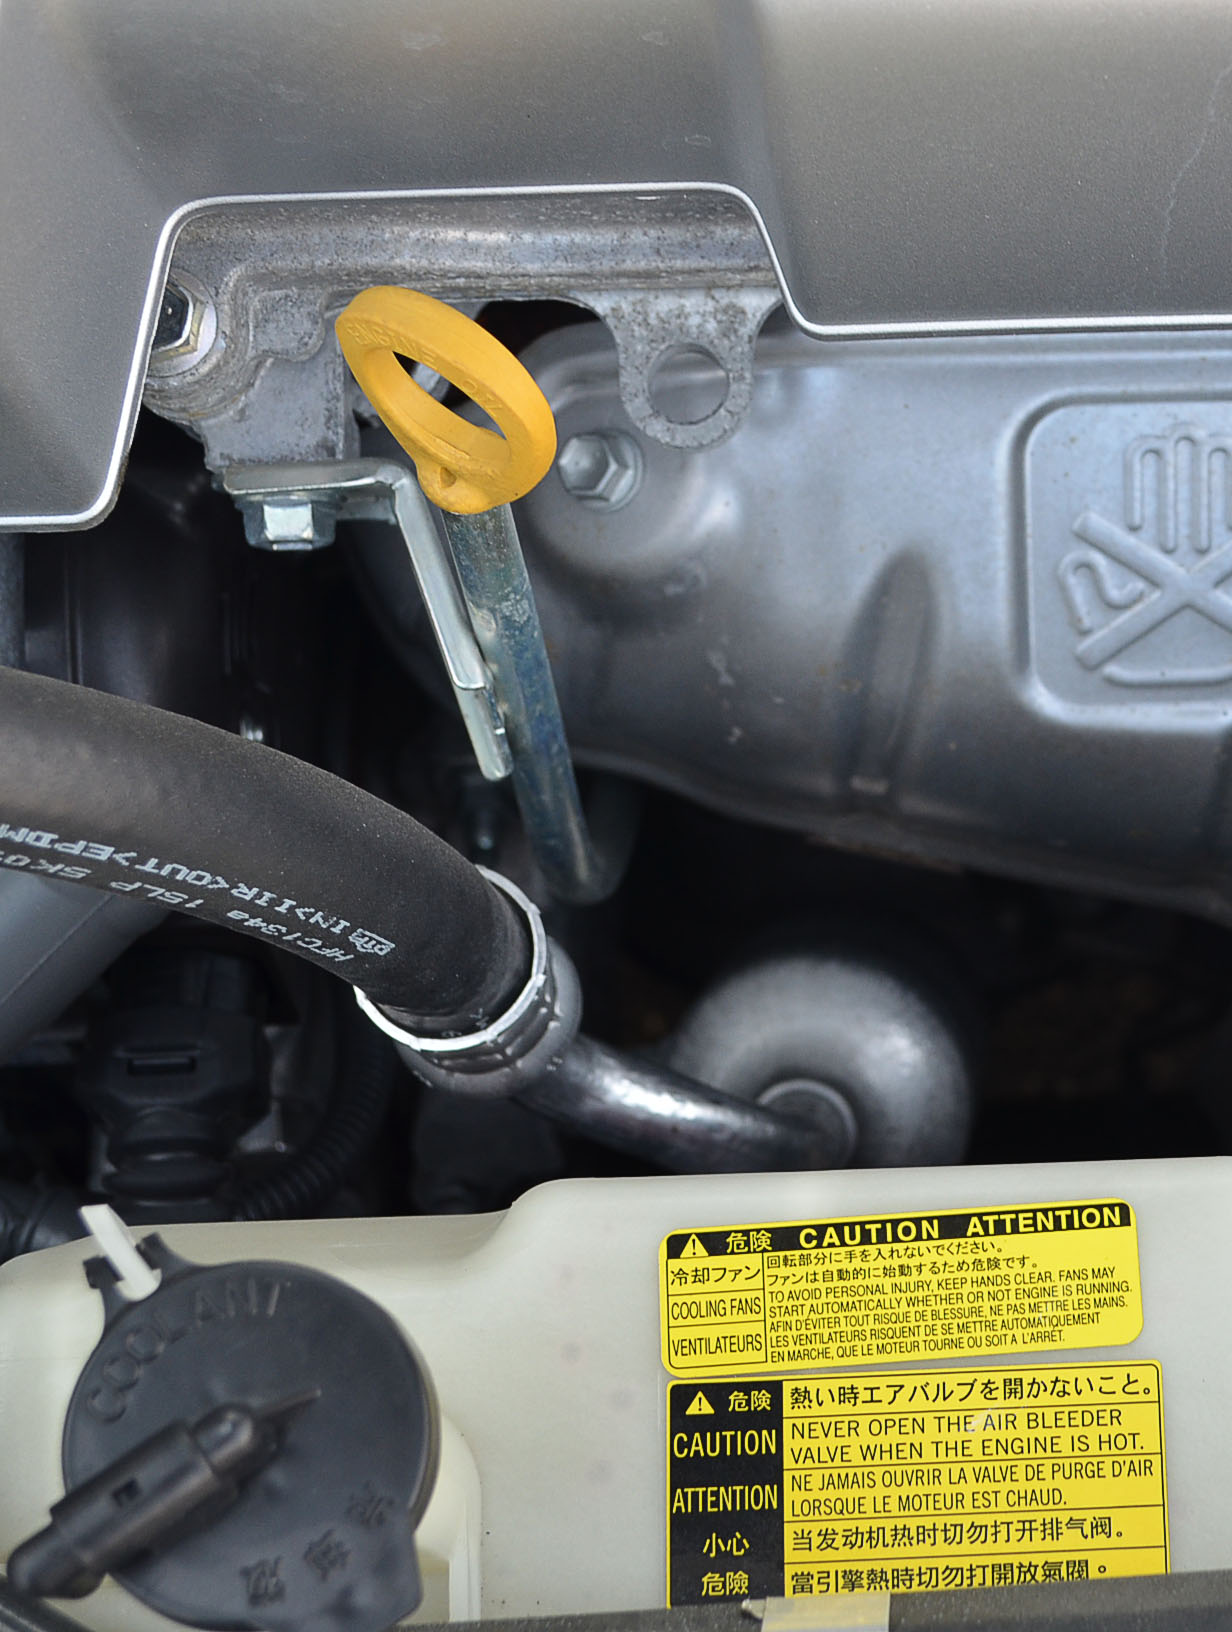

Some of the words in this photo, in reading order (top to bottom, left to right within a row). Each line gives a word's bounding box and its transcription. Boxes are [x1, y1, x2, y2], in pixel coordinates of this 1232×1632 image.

[226, 909, 355, 961] HFC134a
[726, 1230, 772, 1253] 危険
[799, 1219, 939, 1248] CAUTION
[966, 1206, 1120, 1236] ATTENTION
[767, 1240, 1003, 1269] 回転部分に手を入れないでください。
[670, 1265, 761, 1286] 冷却ファン
[767, 1256, 1038, 1286] ファンは自動的に始動するため危険です。
[768, 1288, 784, 1302] TO
[787, 1286, 821, 1301] AVOID
[825, 1281, 888, 1298] PERSONAL
[891, 1278, 933, 1294] INJURY,
[937, 1276, 967, 1291] KEEP
[971, 1273, 1010, 1288] HANDS
[1014, 1270, 1054, 1285] CLEAR.
[1059, 1267, 1088, 1282] FANS
[1091, 1265, 1115, 1280] MAY
[671, 1299, 726, 1320] COOLING
[730, 1297, 761, 1316] FANS
[769, 1302, 805, 1317] START
[808, 1295, 902, 1315] AUTOMATICALLY
[905, 1291, 963, 1308] WHETHER
[966, 1290, 983, 1304] OR
[987, 1288, 1011, 1302] NOT
[1014, 1284, 1058, 1300] ENGINE
[1062, 1283, 1072, 1297] IS
[1076, 1279, 1131, 1296] RUNNING.
[769, 1318, 792, 1332] AFIN
[795, 1314, 840, 1330] D'ÉVITER
[843, 1312, 870, 1327] TOUT
[873, 1309, 911, 1325] RISQUE
[914, 1308, 928, 1322] DE
[931, 1304, 987, 1321] BLESSURE,
[989, 1303, 1003, 1317] NE
[1006, 1302, 1025, 1316] PAS
[1028, 1299, 1069, 1314] METTRE
[1072, 1297, 1090, 1311] LES
[1093, 1295, 1127, 1310] MAINS.
[770, 1333, 789, 1347] LES
[791, 1328, 867, 1346] VENTILATEURS
[870, 1324, 921, 1340] RISQUENT
[924, 1323, 938, 1337] DE
[941, 1322, 954, 1335] SE
[957, 1318, 998, 1334] METTRE
[1000, 1311, 1100, 1331] AUTOMATIQUEMENT
[86, 1277, 292, 1424] COOLANT
[672, 1333, 762, 1357] VENTILATEURS
[770, 1348, 784, 1362] EN
[787, 1345, 833, 1361] MARCHE,
[836, 1343, 858, 1358] QUE
[861, 1342, 873, 1356] LE
[876, 1339, 919, 1355] MOTEUR
[922, 1336, 964, 1352] TOURNE
[967, 1334, 982, 1348] OU
[985, 1333, 1008, 1347] SOIT
[728, 1390, 772, 1412] 危険
[789, 1376, 1153, 1410] 熱い時エアバルブを開かないこと。
[791, 1419, 859, 1440] NEVER
[868, 1417, 924, 1437] OPEN
[933, 1414, 974, 1434] THE
[983, 1413, 1016, 1432] AIR
[1027, 1408, 1121, 1430] BLEEDER
[673, 1430, 777, 1459] CAUTION
[790, 1444, 851, 1464] VALVE
[859, 1441, 922, 1462] WHEN
[931, 1439, 972, 1459] THE
[982, 1436, 1061, 1457] ENGINE
[1071, 1435, 1089, 1453] IS
[1098, 1433, 1143, 1452] HOT.
[791, 1474, 812, 1492] NE
[818, 1471, 875, 1491] JAMAIS
[881, 1469, 941, 1488] OUVRIR
[948, 1468, 967, 1485] LA
[972, 1465, 1018, 1484] VALVE
[1025, 1464, 1045, 1482] DE
[1051, 1462, 1105, 1481] PURGE
[1111, 1460, 1152, 1479] D'AIR
[672, 1484, 778, 1513] ATTENTION
[791, 1497, 866, 1517] LORSQUE
[873, 1496, 891, 1514] LE
[898, 1493, 964, 1512] MOTEUR
[971, 1491, 1000, 1509] EST
[1006, 1488, 1066, 1508] CHAUD.
[702, 1531, 750, 1558] 小心
[791, 1516, 1124, 1551] 当发动机热时切勿打开排气阀。
[701, 1571, 749, 1597] 危險
